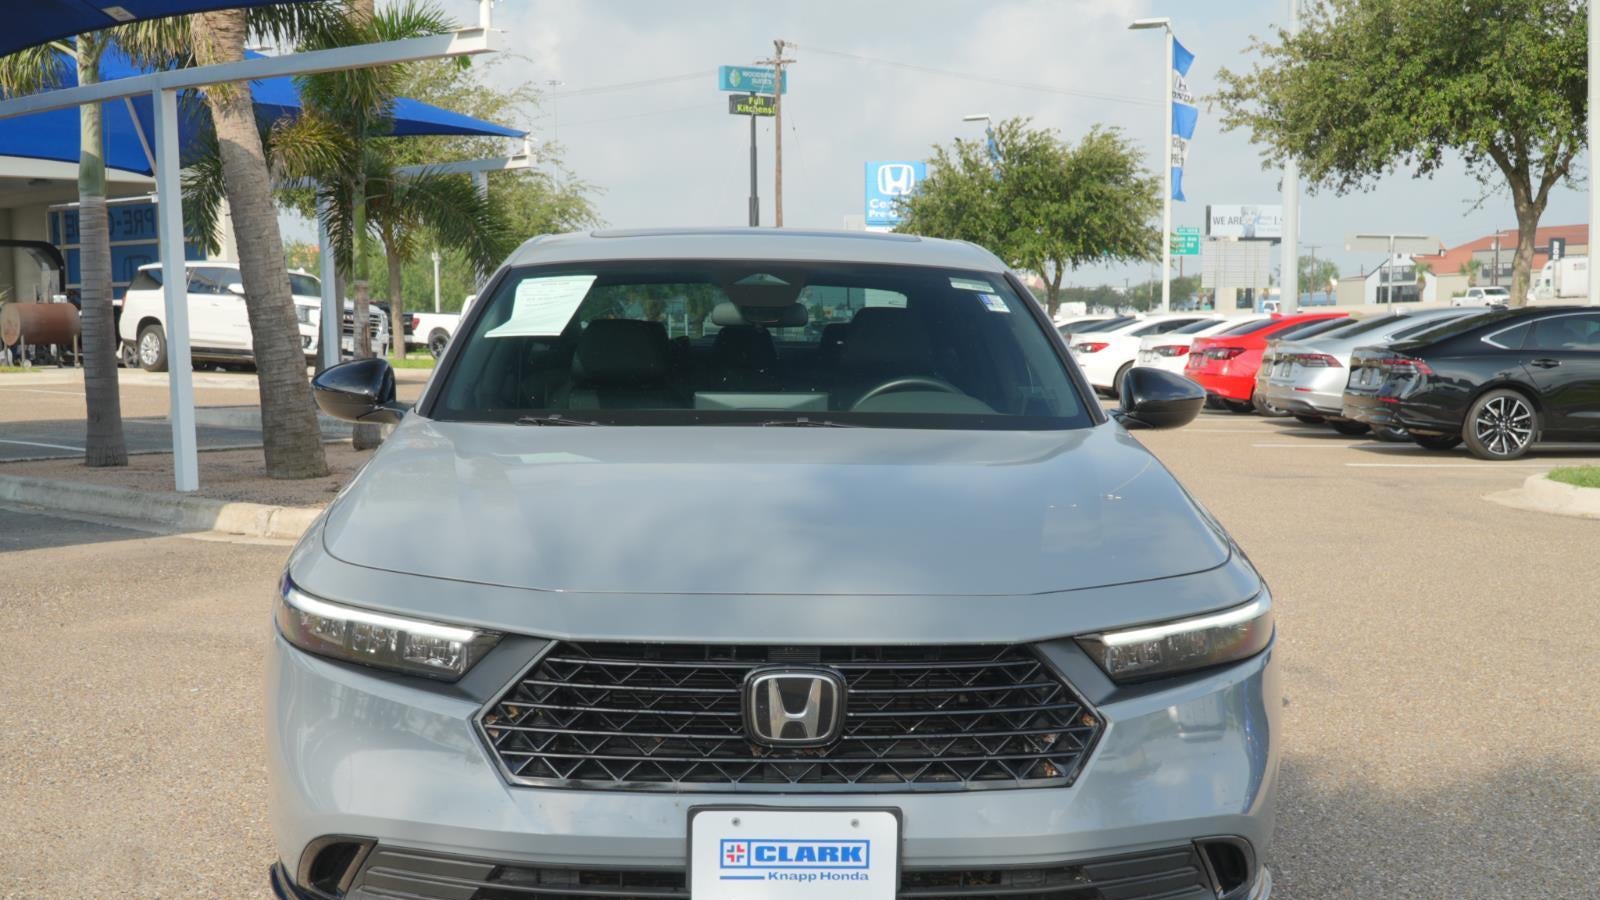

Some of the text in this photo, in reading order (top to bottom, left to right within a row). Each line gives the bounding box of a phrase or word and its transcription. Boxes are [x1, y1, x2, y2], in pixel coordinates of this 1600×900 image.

[749, 96, 764, 105] Full
[869, 209, 898, 217] Pre-O
[1213, 216, 1223, 225] WE
[755, 846, 863, 862] CLARK
[768, 871, 869, 882] Knapp Honda
